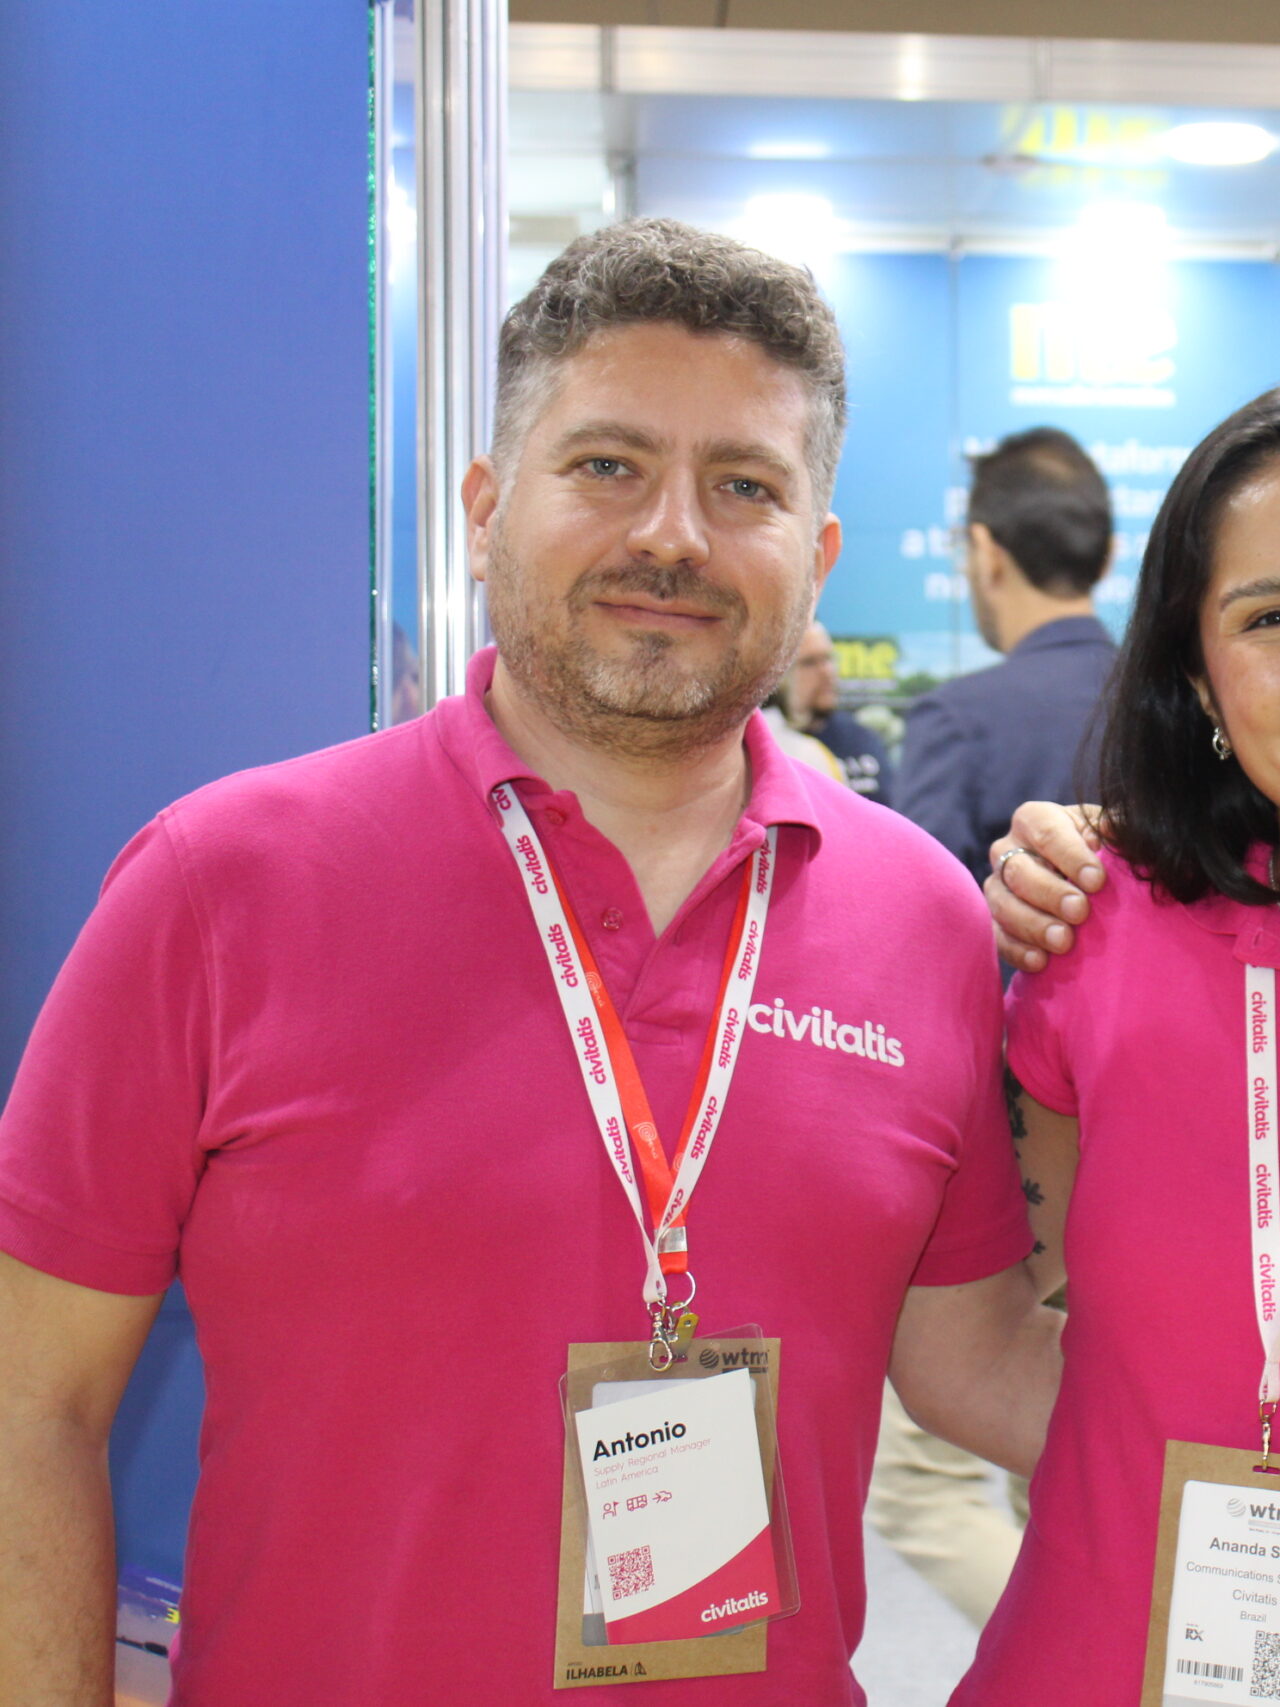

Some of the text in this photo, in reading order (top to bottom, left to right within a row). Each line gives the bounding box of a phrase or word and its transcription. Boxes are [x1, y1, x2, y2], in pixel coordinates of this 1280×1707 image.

[516, 834, 548, 895] civitatis
[555, 923, 579, 988] civitatis
[738, 919, 759, 981] civitatis
[578, 1016, 607, 1085] civitatis
[718, 1007, 739, 1069] civitatis
[746, 998, 905, 1067] civitatis
[1251, 991, 1265, 1054] civitatis
[690, 1096, 717, 1160] civitatis
[1253, 1076, 1267, 1140] civitatis
[606, 1116, 633, 1184] civitatis
[1255, 1163, 1270, 1229] civitatis
[1258, 1253, 1276, 1322] civitatis
[592, 1421, 687, 1462] Antonio
[594, 1438, 712, 1477] Supply Regional Manager
[595, 1465, 659, 1490] Latin America
[1186, 1560, 1274, 1584] Communications
[1208, 1536, 1266, 1557] Ananda
[701, 1590, 769, 1623] civitatis
[1232, 1588, 1278, 1606] Civitatis
[1239, 1610, 1267, 1624] Brazil
[566, 1665, 628, 1680] ILHABELA
